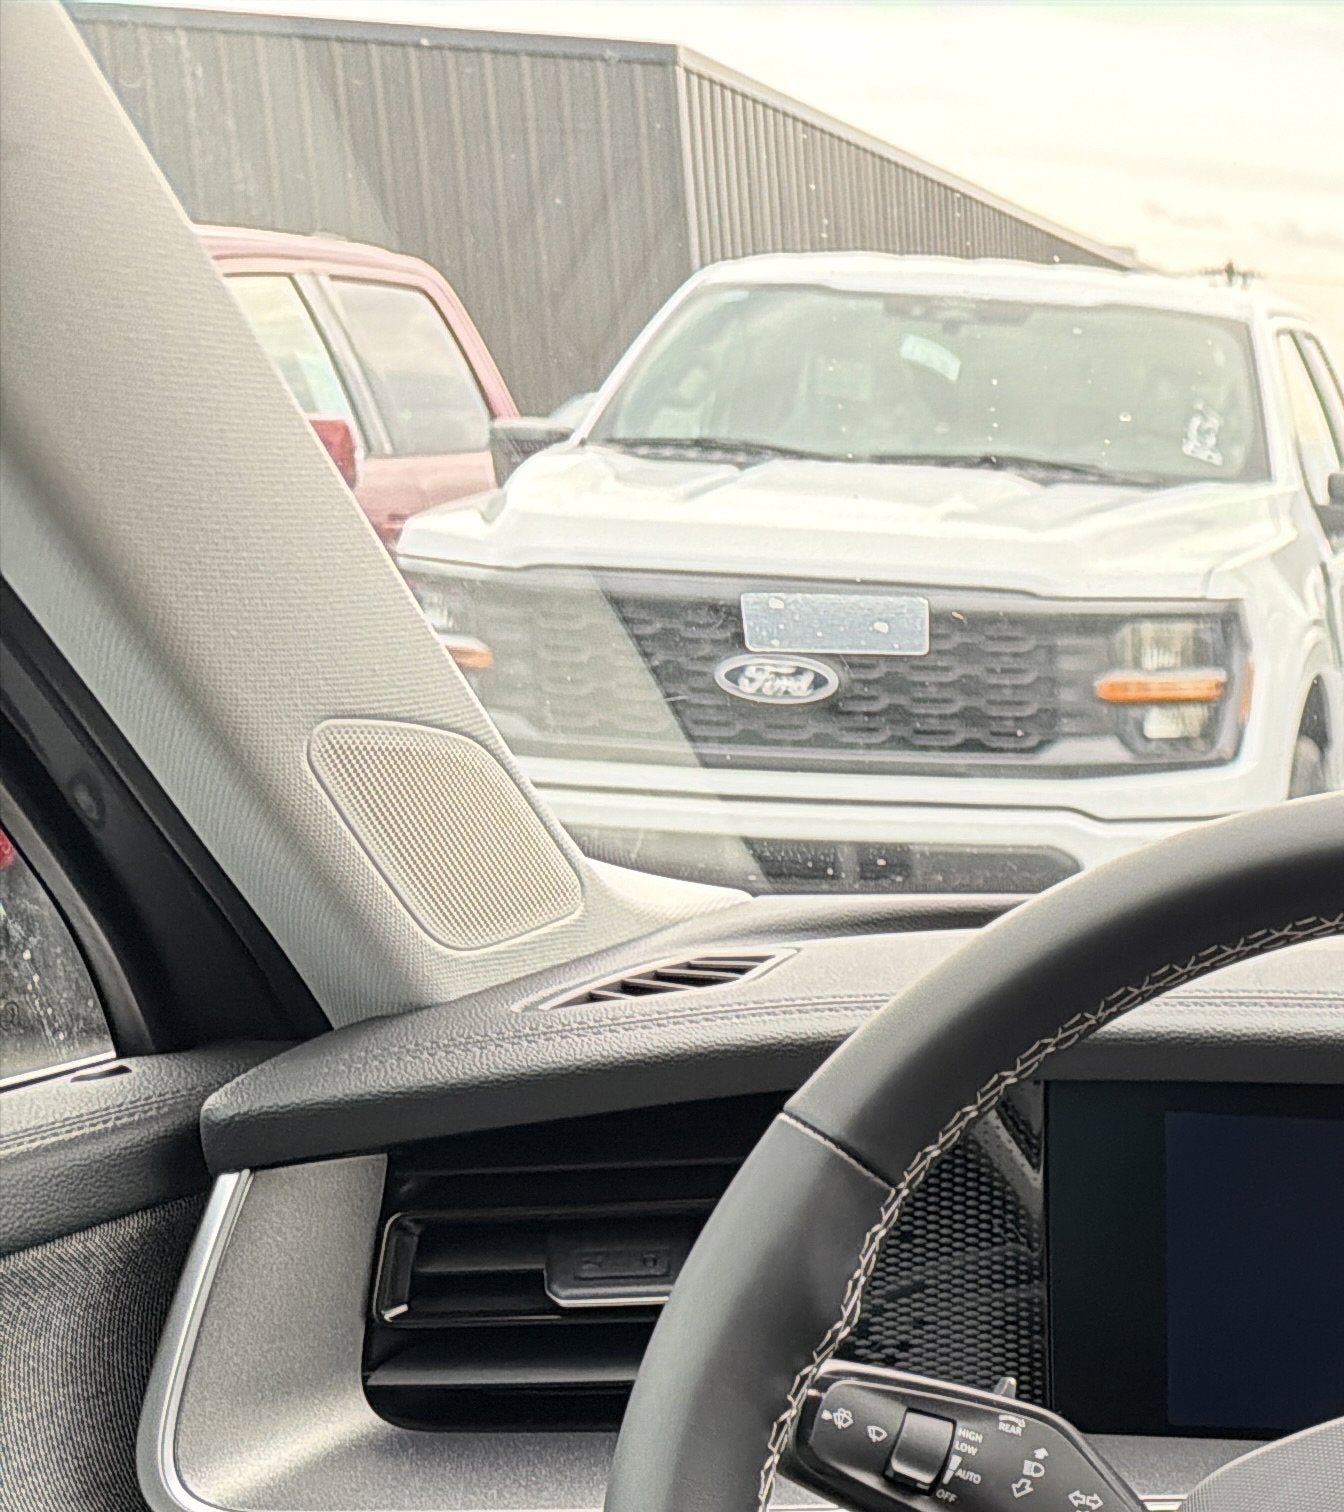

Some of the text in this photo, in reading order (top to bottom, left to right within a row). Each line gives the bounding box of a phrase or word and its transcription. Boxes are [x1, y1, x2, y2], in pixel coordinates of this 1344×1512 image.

[736, 658, 816, 687] Ford
[957, 1427, 984, 1444] HIGH
[998, 1421, 1023, 1436] REAR
[953, 1441, 979, 1457] LOW
[955, 1467, 982, 1485] AUTO
[935, 1488, 958, 1503] OFF
